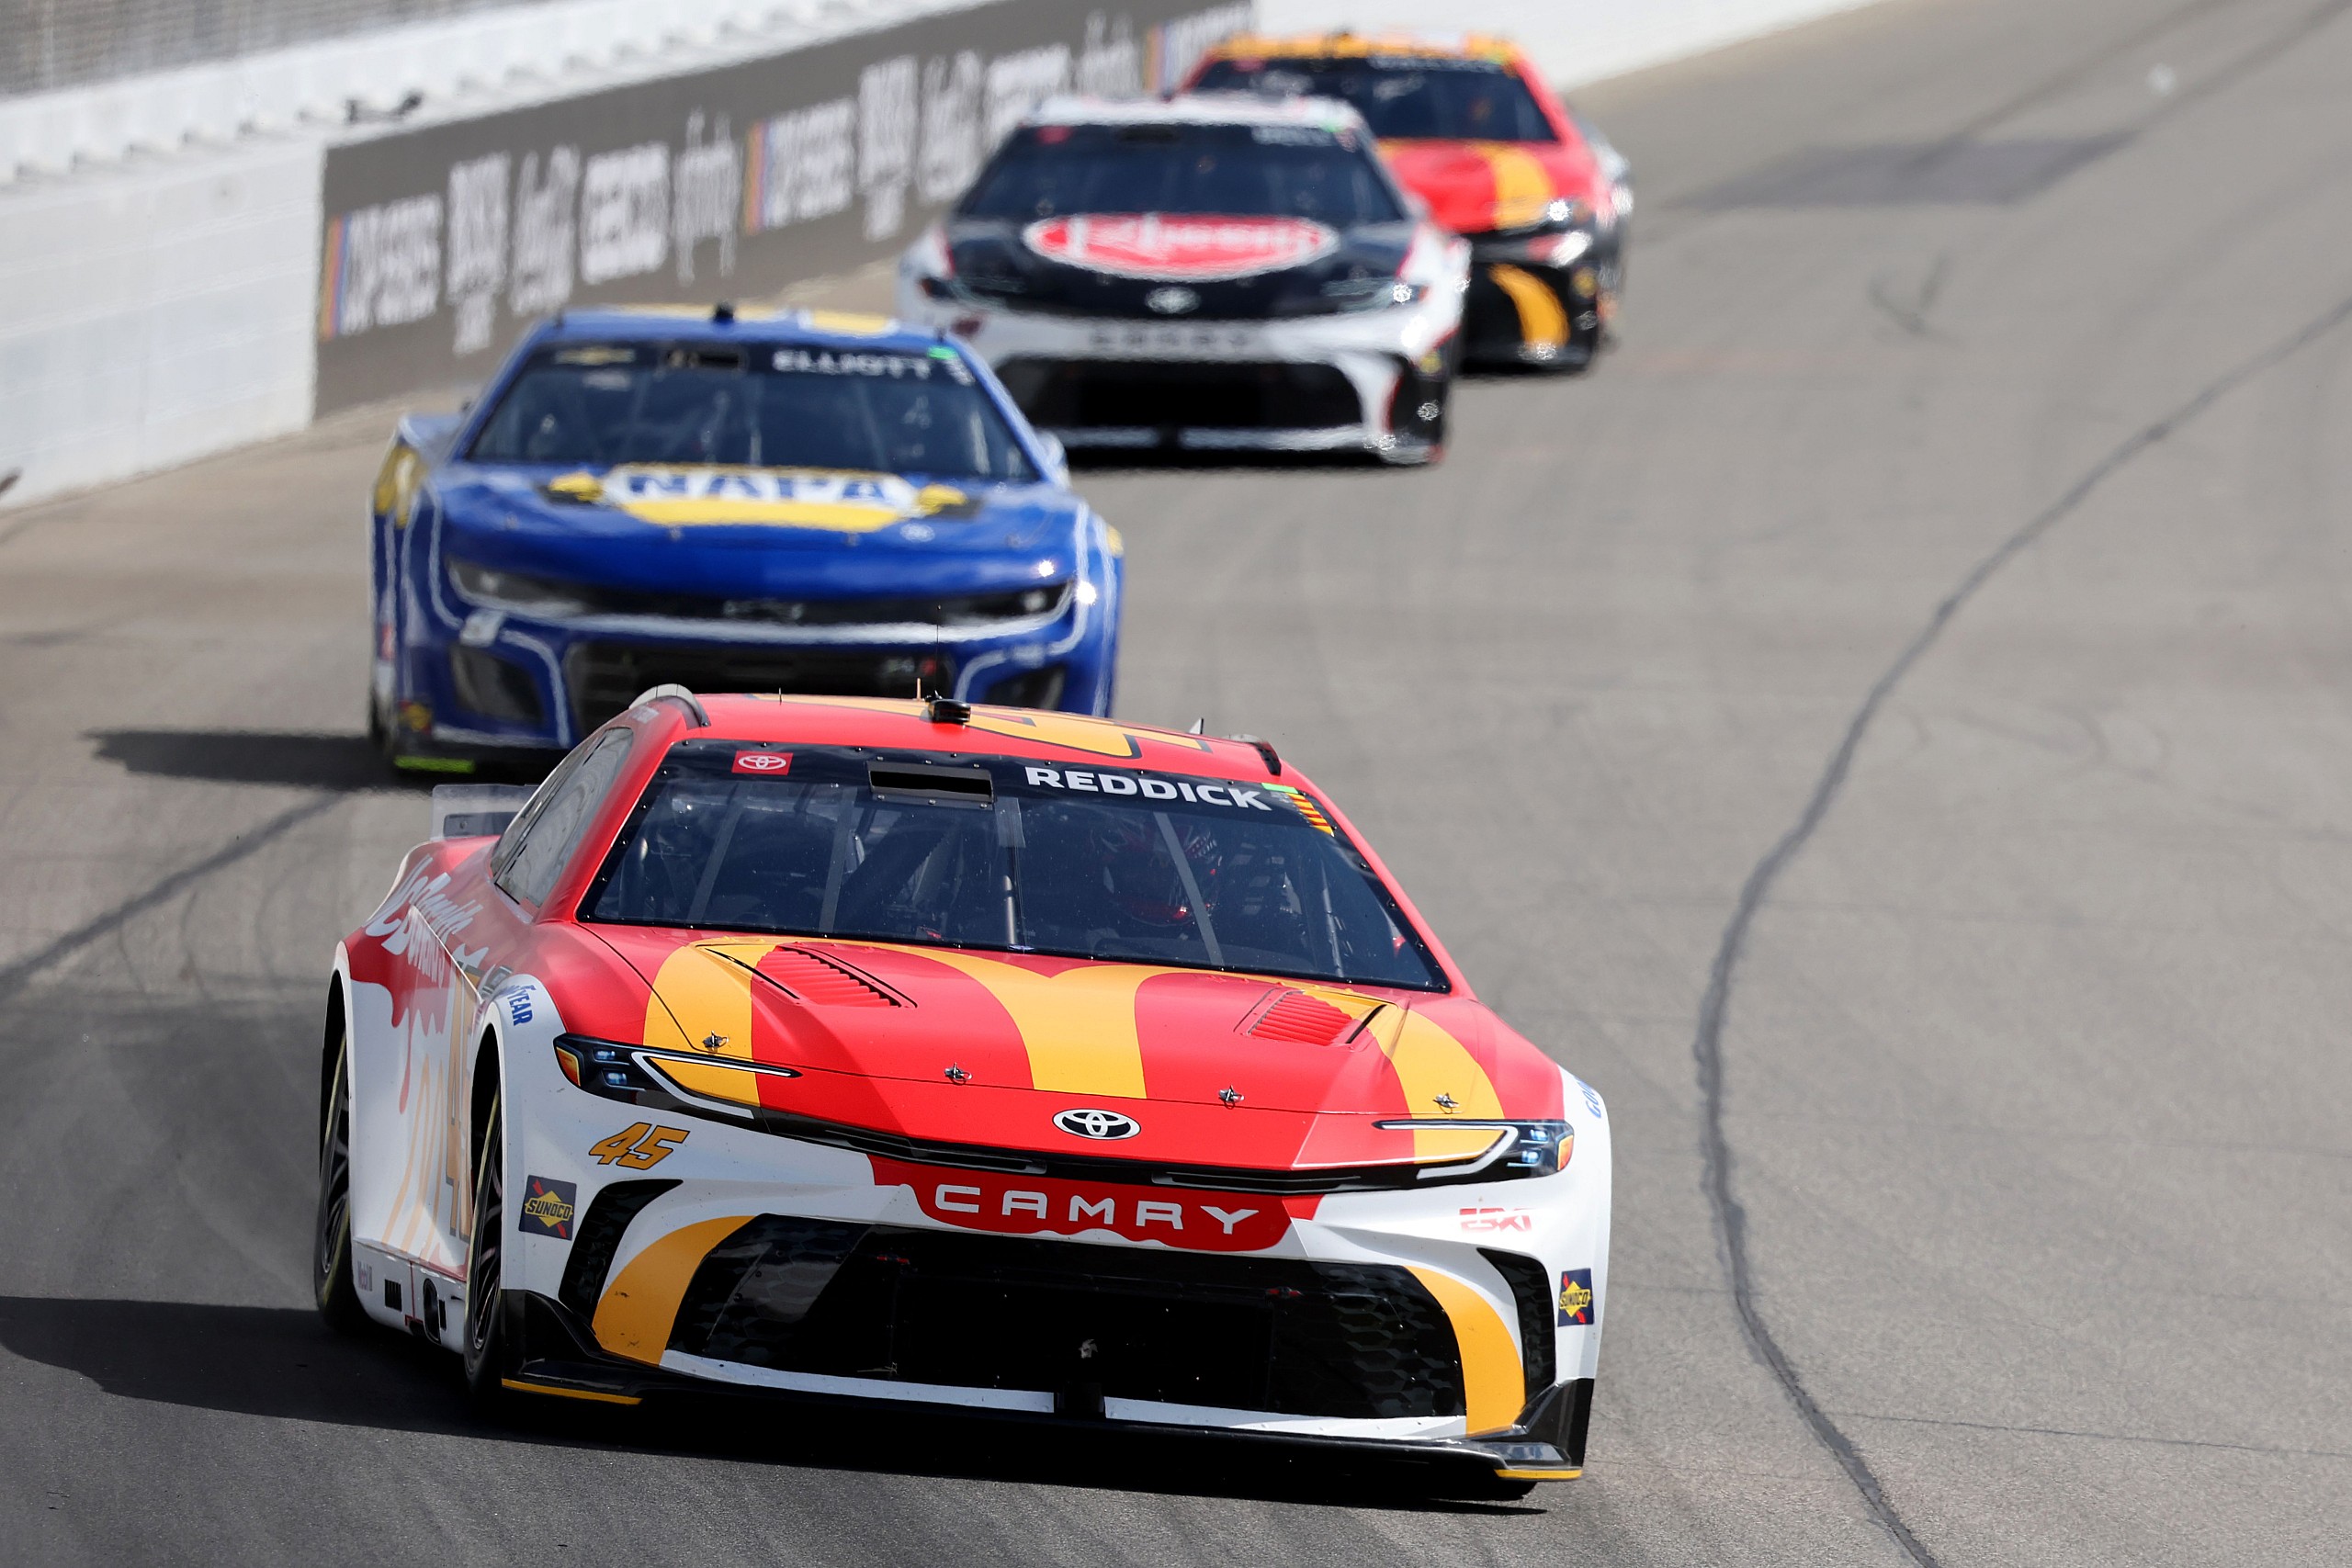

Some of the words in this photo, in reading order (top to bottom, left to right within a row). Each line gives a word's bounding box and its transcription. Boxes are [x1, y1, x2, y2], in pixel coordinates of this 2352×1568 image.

[773, 349, 931, 379] ELLIOTT
[1024, 766, 1272, 811] REDDICK
[588, 1122, 691, 1171] 45
[526, 1199, 573, 1220] SUNOCO
[935, 1183, 1260, 1235] CAMRY
[1559, 1291, 1590, 1308] SUNOCO
